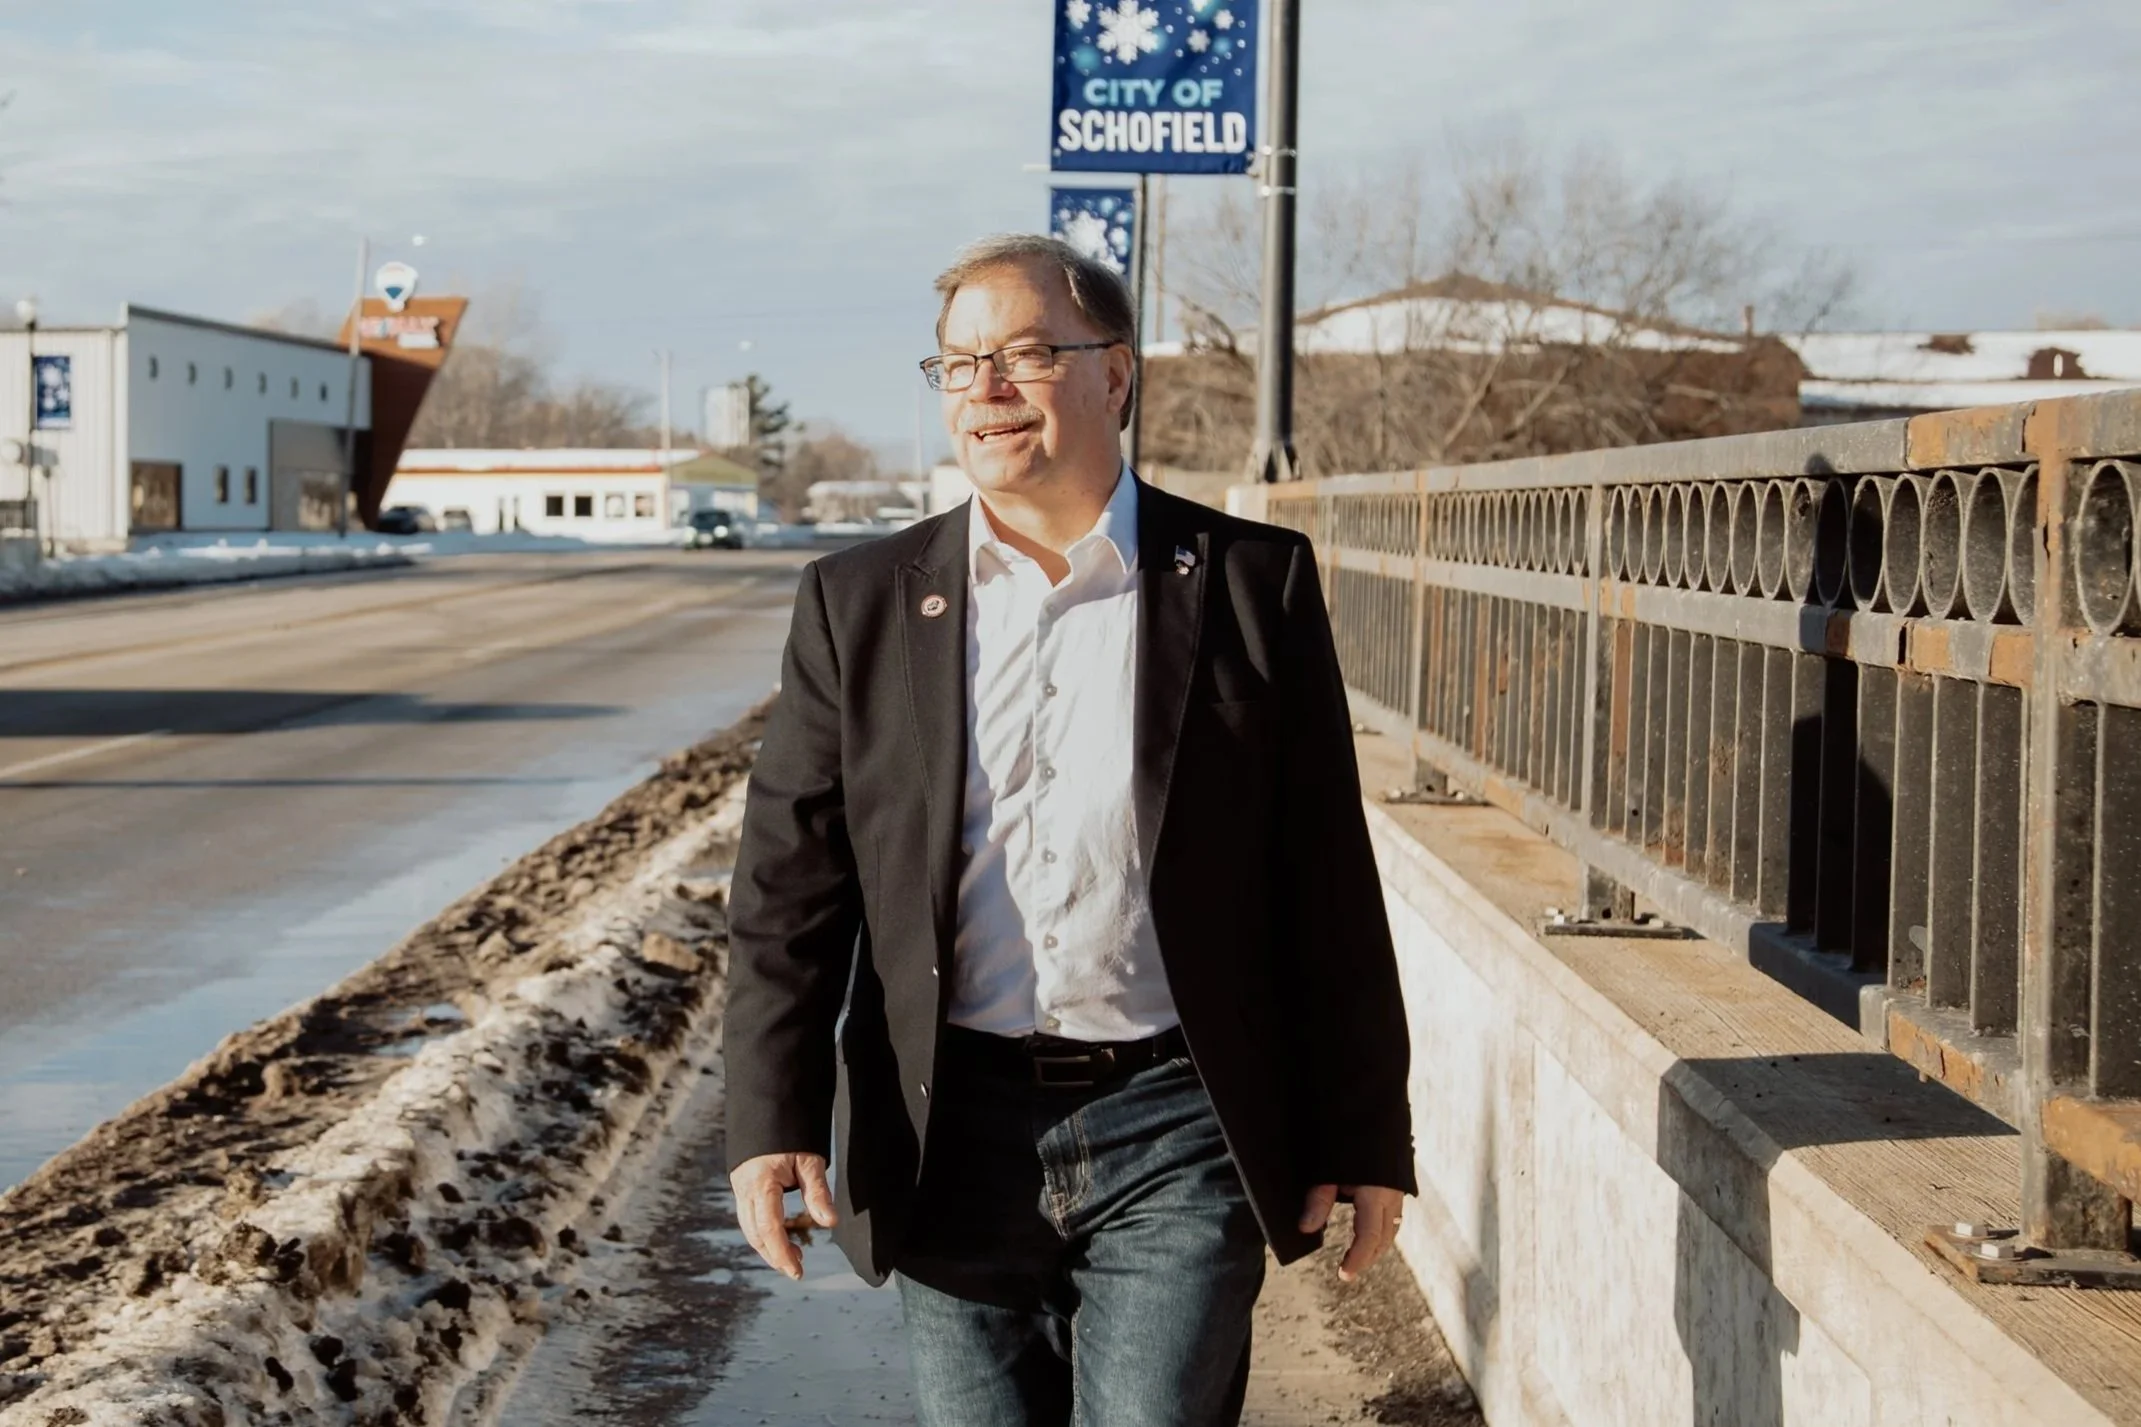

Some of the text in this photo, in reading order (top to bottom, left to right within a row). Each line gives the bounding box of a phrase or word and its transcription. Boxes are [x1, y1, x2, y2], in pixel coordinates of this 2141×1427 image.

[1083, 78, 1223, 107] CITY OF
[1058, 108, 1247, 154] SCHOFIELD
